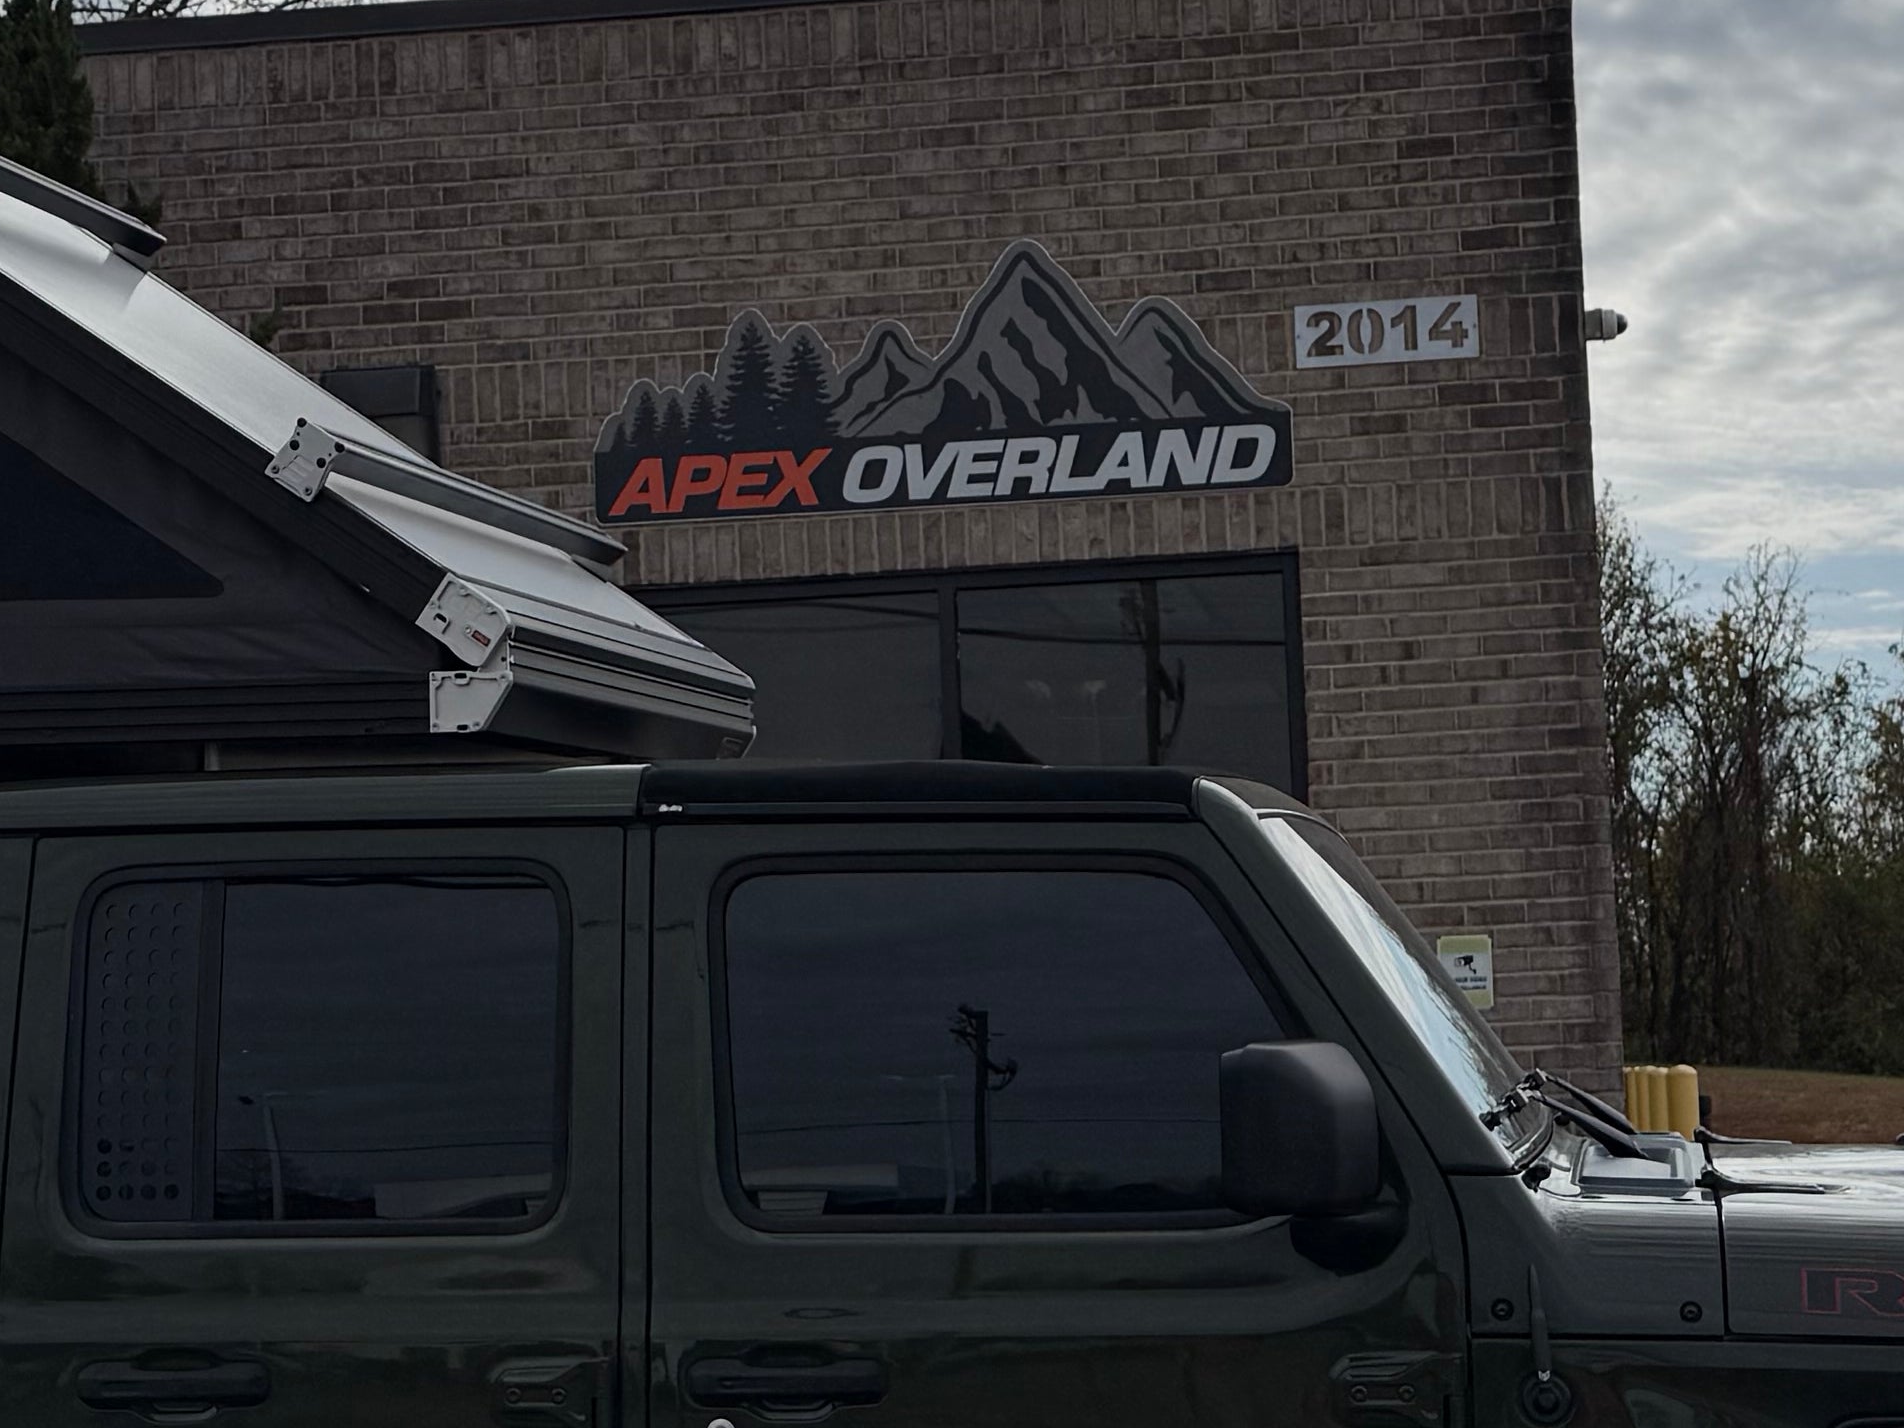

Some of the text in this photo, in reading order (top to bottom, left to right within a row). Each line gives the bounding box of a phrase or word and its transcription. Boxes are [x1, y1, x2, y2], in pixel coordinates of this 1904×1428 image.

[1305, 299, 1471, 358] 2014
[608, 423, 1277, 517] APEX OVERLAND
